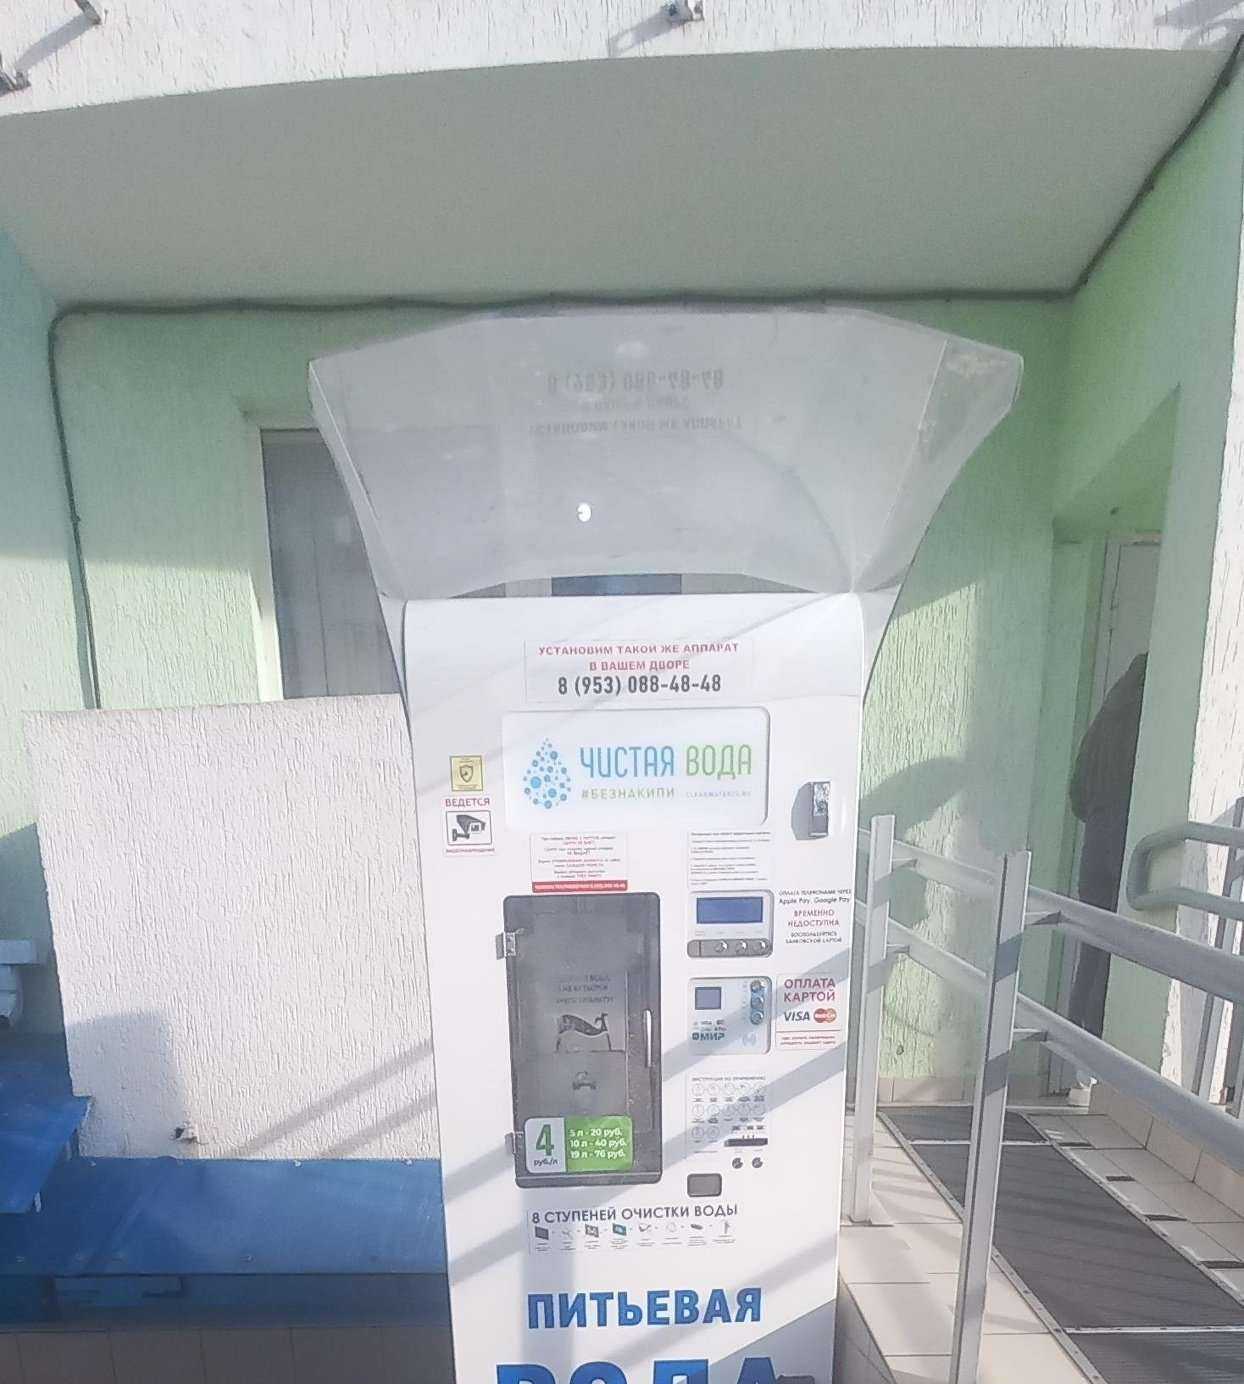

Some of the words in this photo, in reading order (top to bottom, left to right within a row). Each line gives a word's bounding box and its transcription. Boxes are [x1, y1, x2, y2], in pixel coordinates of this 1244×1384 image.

[538, 645, 613, 656] УСТАНОВИМ
[661, 644, 679, 654] ЖЕ
[685, 643, 739, 653] АППАРАТ
[589, 661, 597, 671] В
[601, 660, 646, 671] ВАШЕМ
[649, 660, 689, 672] ДВОРЕ
[558, 676, 568, 695] 8
[574, 675, 622, 696] (953)
[628, 674, 722, 694] 088-48-48
[580, 745, 675, 778] ЧИСТАЯ
[686, 744, 752, 780] ВОДА
[581, 787, 675, 800] #БЕЗНАКИПИ
[445, 798, 490, 807] ВЕДЕТСЯ
[794, 908, 835, 917] ВРЕМЕННО
[788, 919, 840, 928] НЕДОСТУПНА
[784, 978, 836, 989] ОПЛАТА
[784, 989, 836, 1002] КАРТОЙ
[784, 1011, 811, 1022] VISA
[590, 1128, 602, 1136] 20
[603, 1128, 622, 1138] руб.
[535, 1124, 555, 1157] 4
[570, 1139, 580, 1147] 10
[595, 1139, 607, 1147] 40
[531, 1212, 540, 1224] 8
[544, 1207, 616, 1224] СТУПЕНЕЙ
[621, 1206, 690, 1220] ОЧИСТКИ
[694, 1205, 738, 1217] ВОДЫ
[527, 1287, 762, 1329] ПИТЬЕВАЯ
